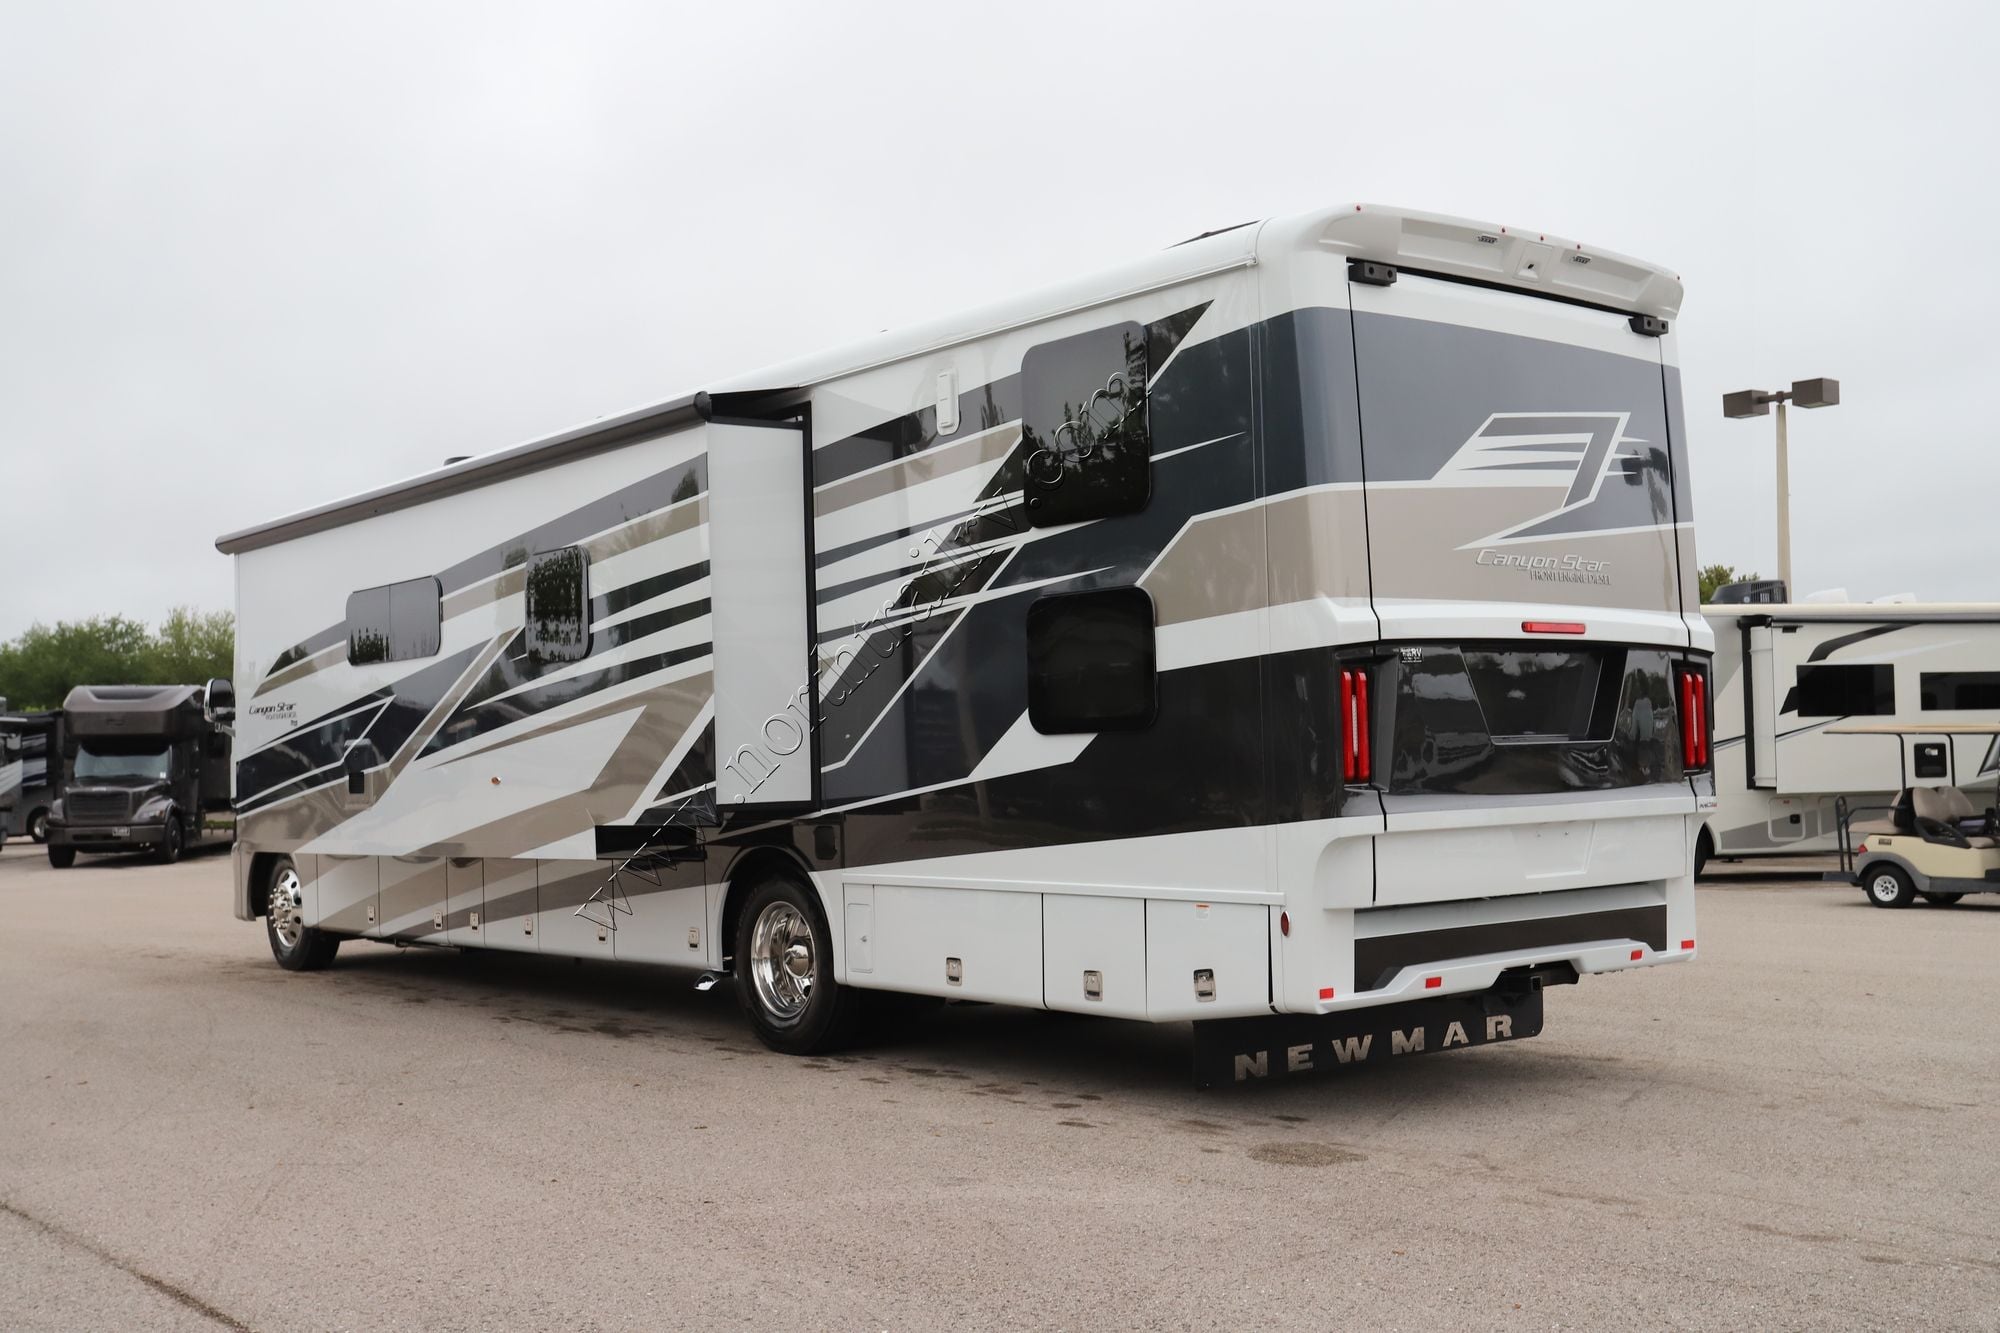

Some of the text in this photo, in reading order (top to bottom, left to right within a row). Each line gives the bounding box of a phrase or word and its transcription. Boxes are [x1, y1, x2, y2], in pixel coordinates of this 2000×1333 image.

[1475, 548, 1610, 572] Canyon Star
[248, 705, 276, 716] Canyon
[277, 702, 297, 712] Star
[1234, 1014, 1512, 1081] NEWMAR
